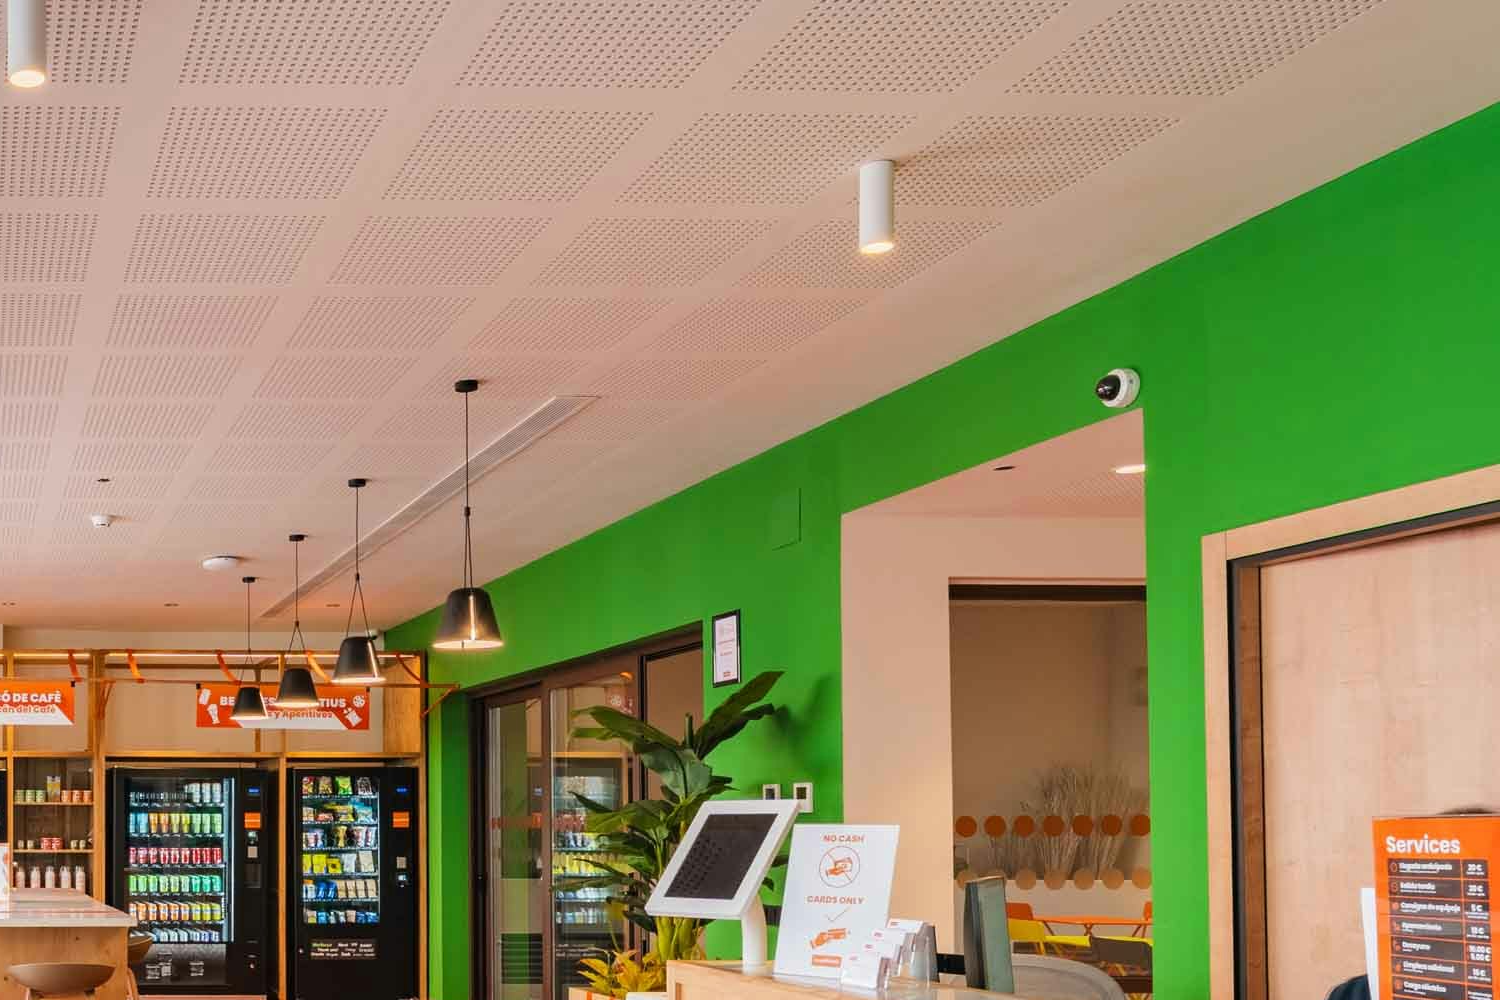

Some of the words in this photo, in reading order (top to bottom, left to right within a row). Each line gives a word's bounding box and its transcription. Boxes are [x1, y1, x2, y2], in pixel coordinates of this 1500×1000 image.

[12, 692, 29, 702] DE
[16, 703, 32, 713] del
[823, 834, 837, 843] NO
[838, 834, 865, 844] CASH
[1386, 833, 1461, 854] Services
[806, 895, 838, 904] CARDS
[839, 895, 865, 905] ONLY
